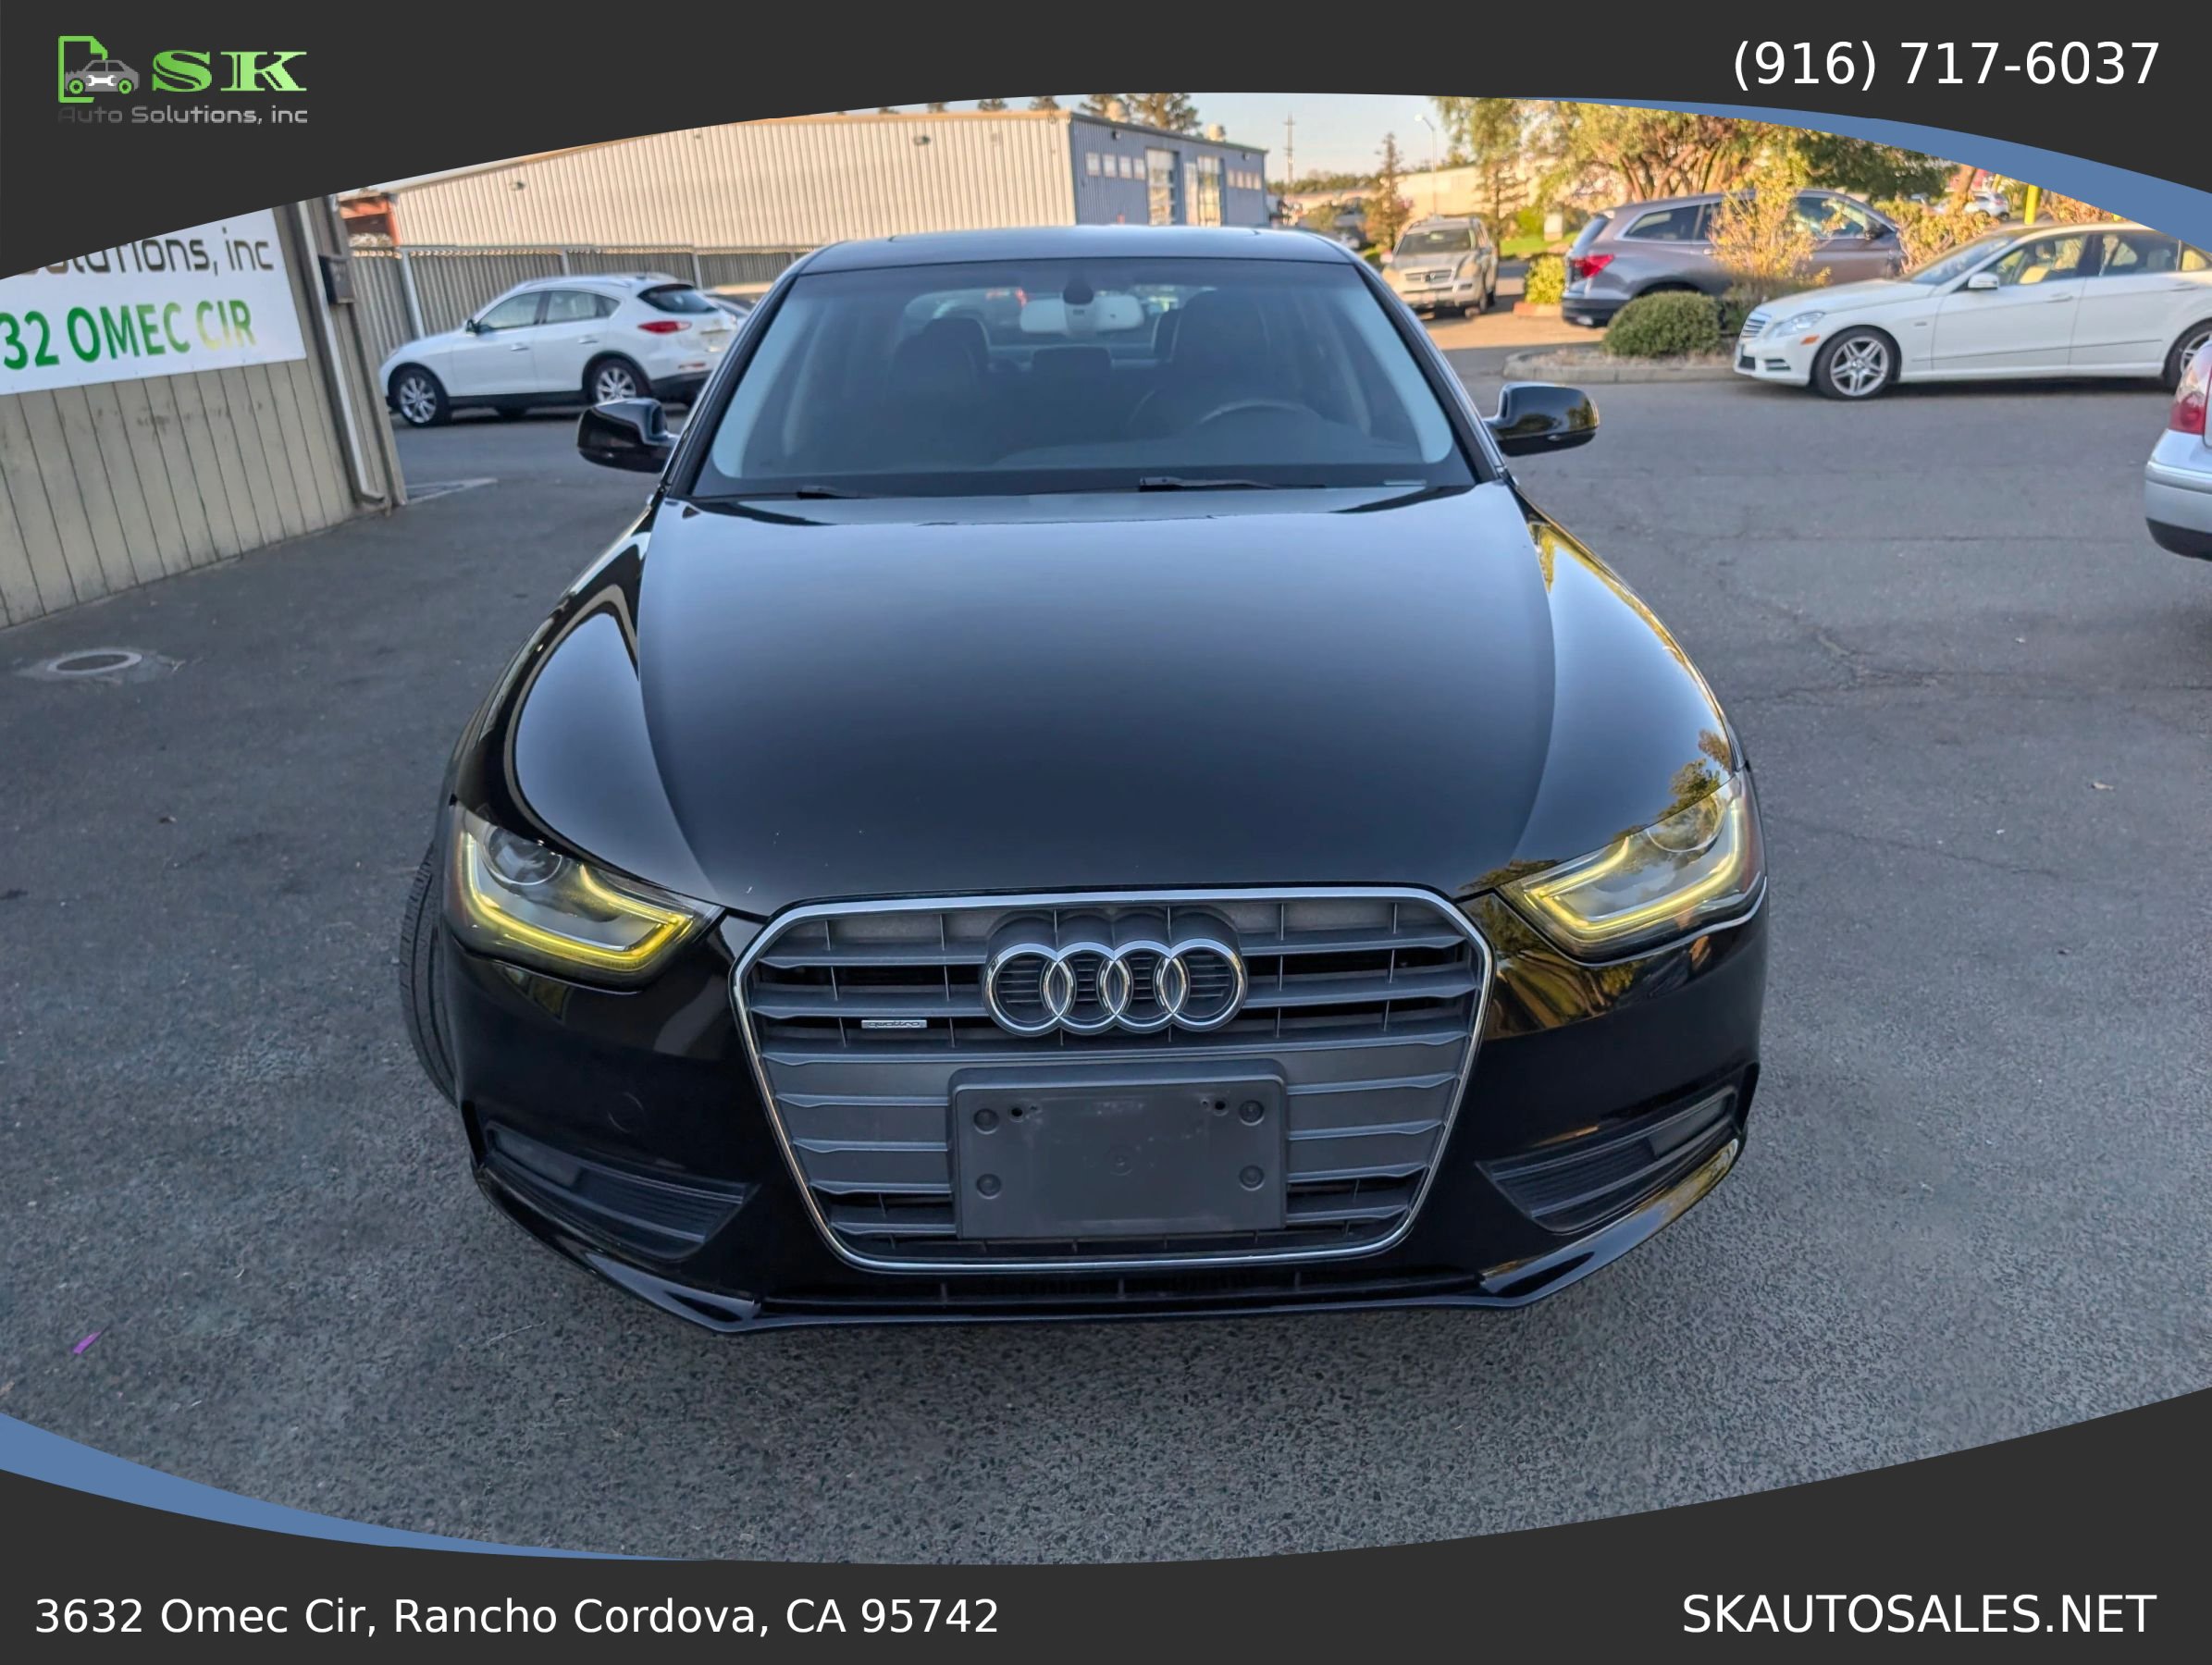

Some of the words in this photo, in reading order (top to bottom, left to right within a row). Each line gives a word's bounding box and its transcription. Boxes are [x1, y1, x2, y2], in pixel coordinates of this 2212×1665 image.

[221, 227, 274, 271] inc
[67, 302, 191, 363] OMEC
[195, 299, 256, 350] CIR
